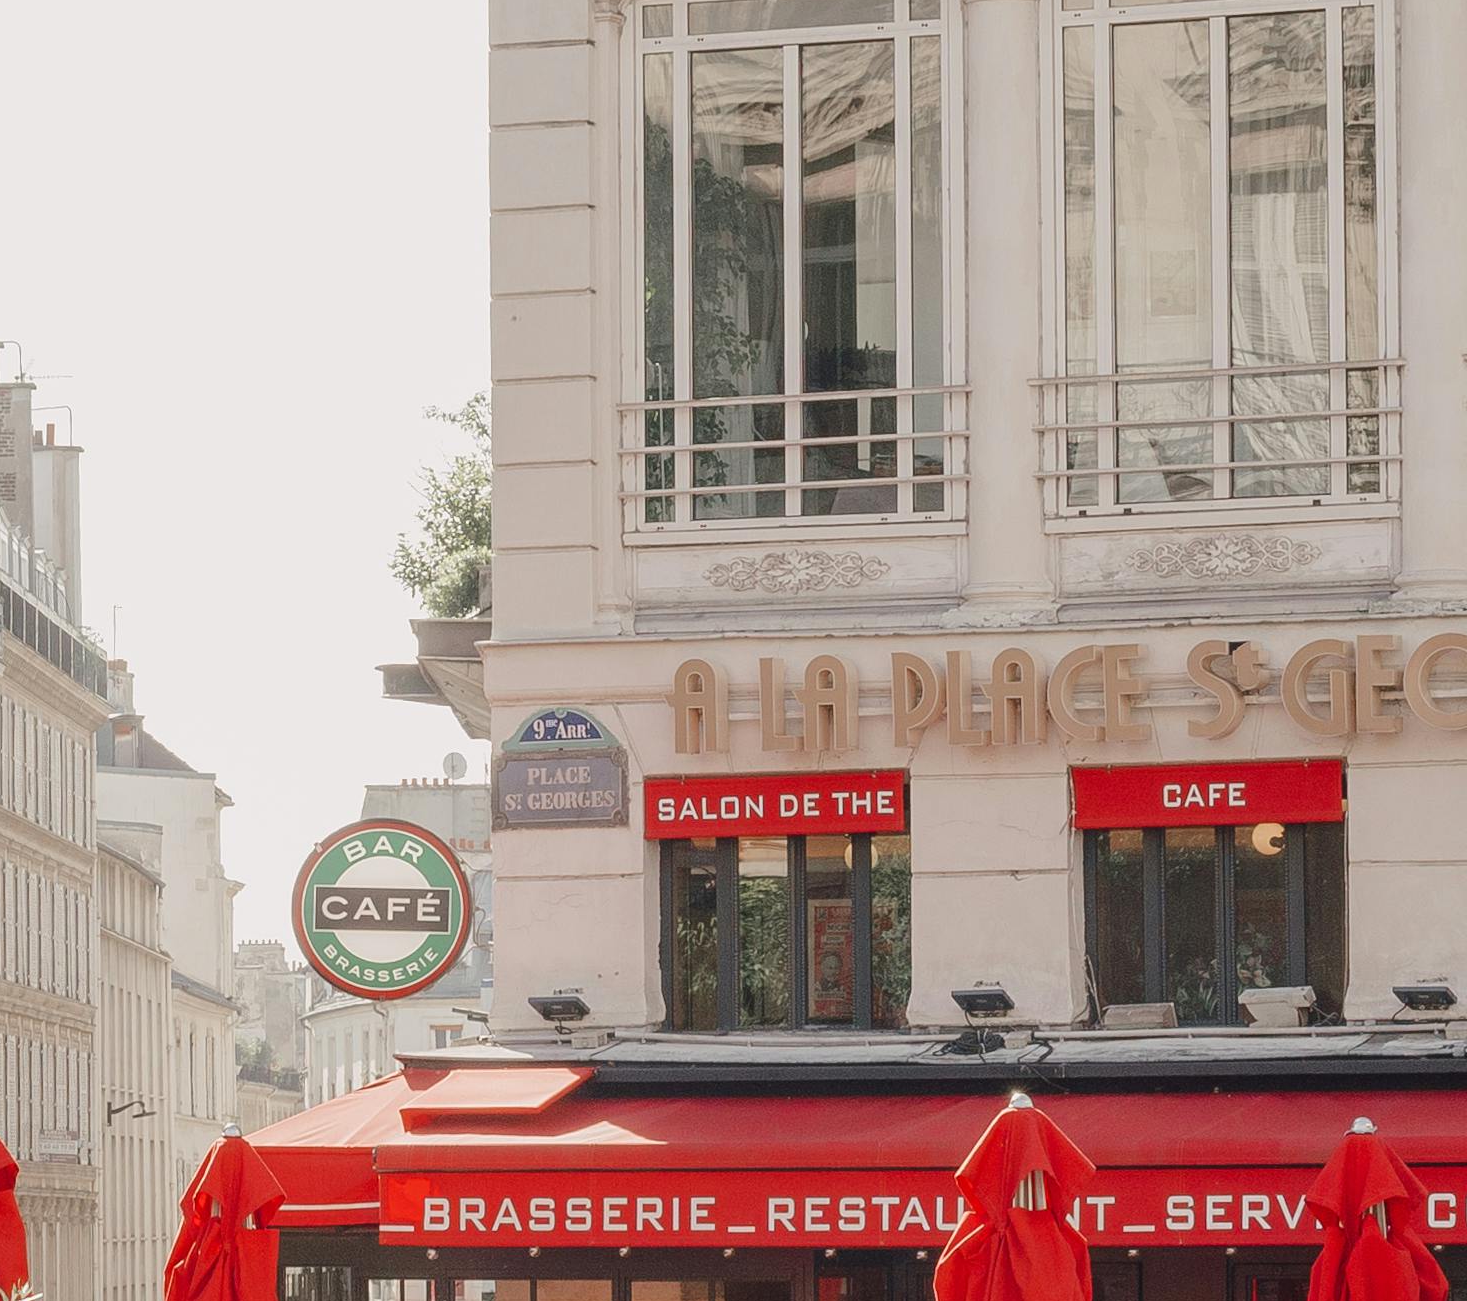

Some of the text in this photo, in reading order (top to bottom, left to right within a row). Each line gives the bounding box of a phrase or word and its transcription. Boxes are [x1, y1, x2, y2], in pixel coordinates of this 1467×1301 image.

[665, 658, 728, 754] A
[759, 649, 859, 752] LA
[891, 642, 1152, 749] PLACE
[527, 766, 592, 785] PLACE
[528, 790, 615, 811] GEORGES
[657, 789, 895, 822] SALON DE THE
[1162, 781, 1246, 808] CAFE
[342, 835, 424, 863] BAR
[321, 892, 441, 923] CAFÉ
[323, 943, 440, 983] BRASSERIE
[422, 1196, 717, 1232] BRASSERIE
